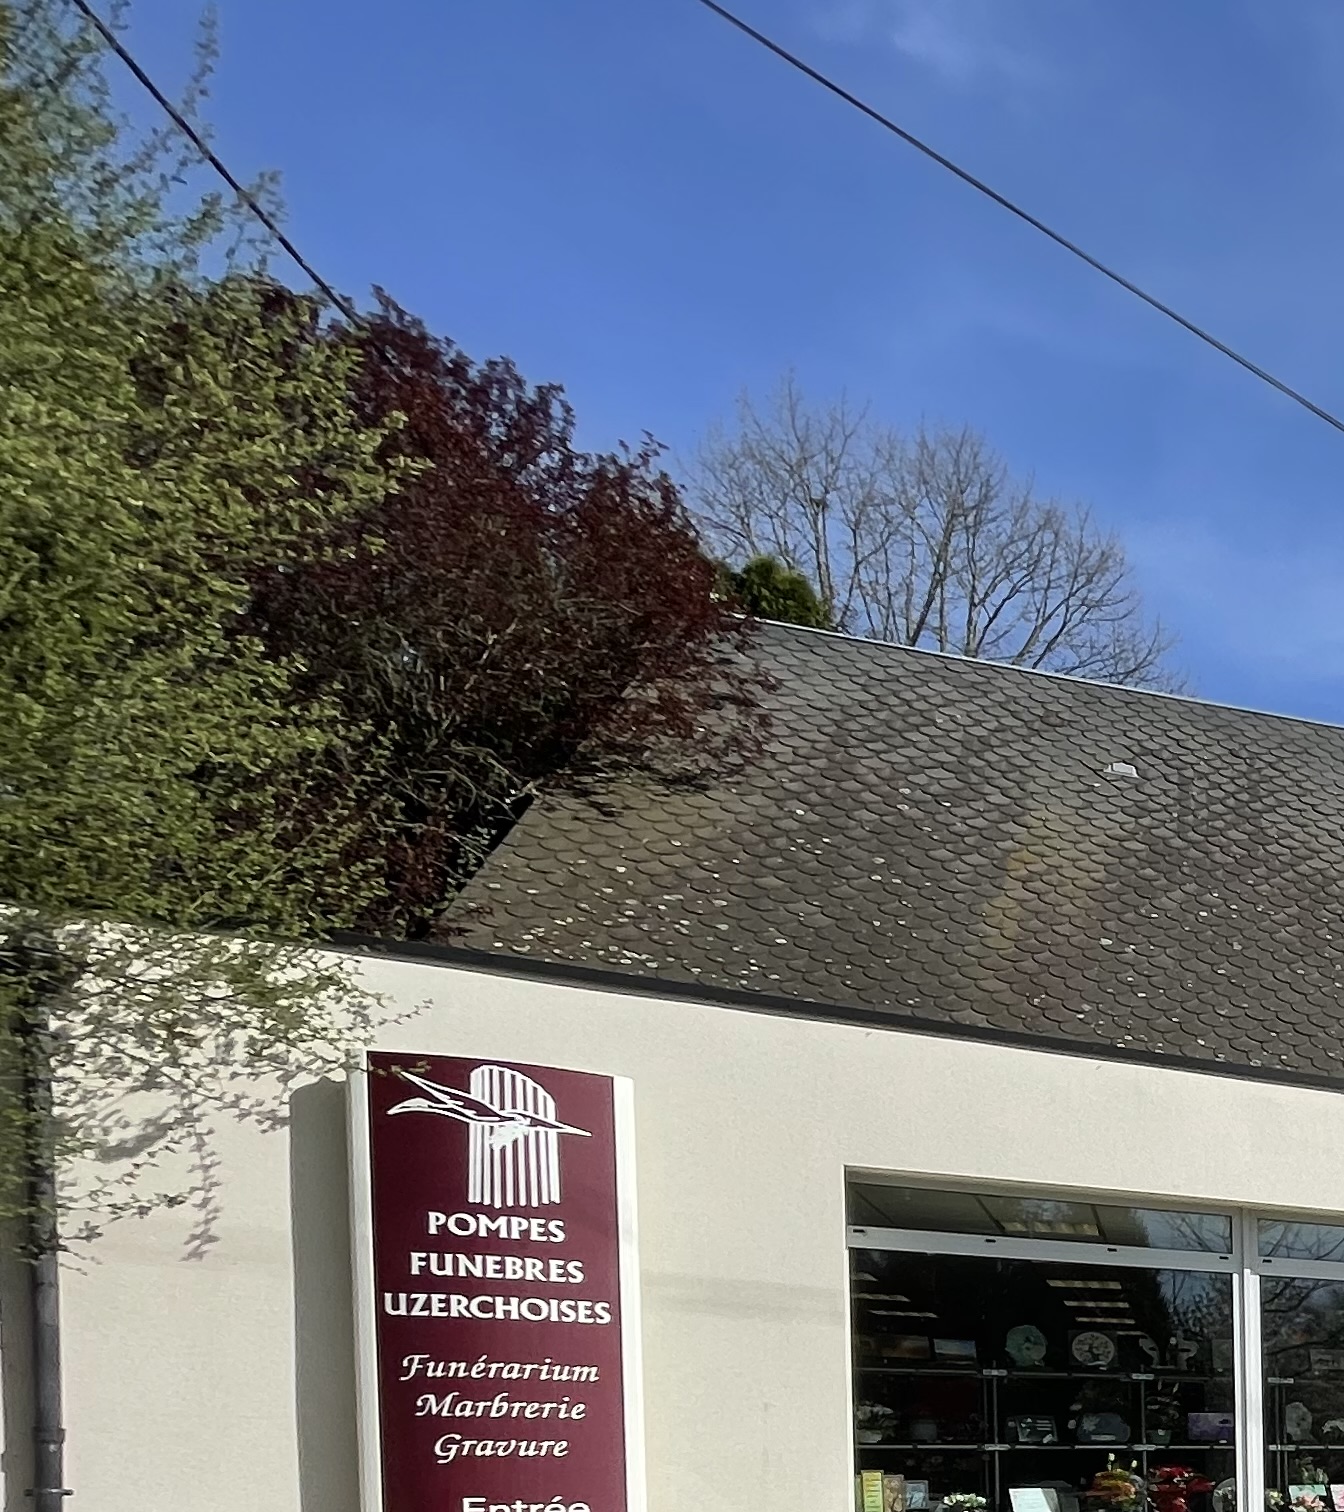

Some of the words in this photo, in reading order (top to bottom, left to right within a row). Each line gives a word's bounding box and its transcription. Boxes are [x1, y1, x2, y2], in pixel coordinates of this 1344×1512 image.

[427, 1211, 567, 1243] POMPES
[409, 1251, 585, 1284] FUNEBRES
[384, 1292, 612, 1325] UZERCHOISES
[399, 1354, 600, 1382] Funérarium
[414, 1391, 587, 1420] Marbrerie
[433, 1433, 570, 1464] Gravure
